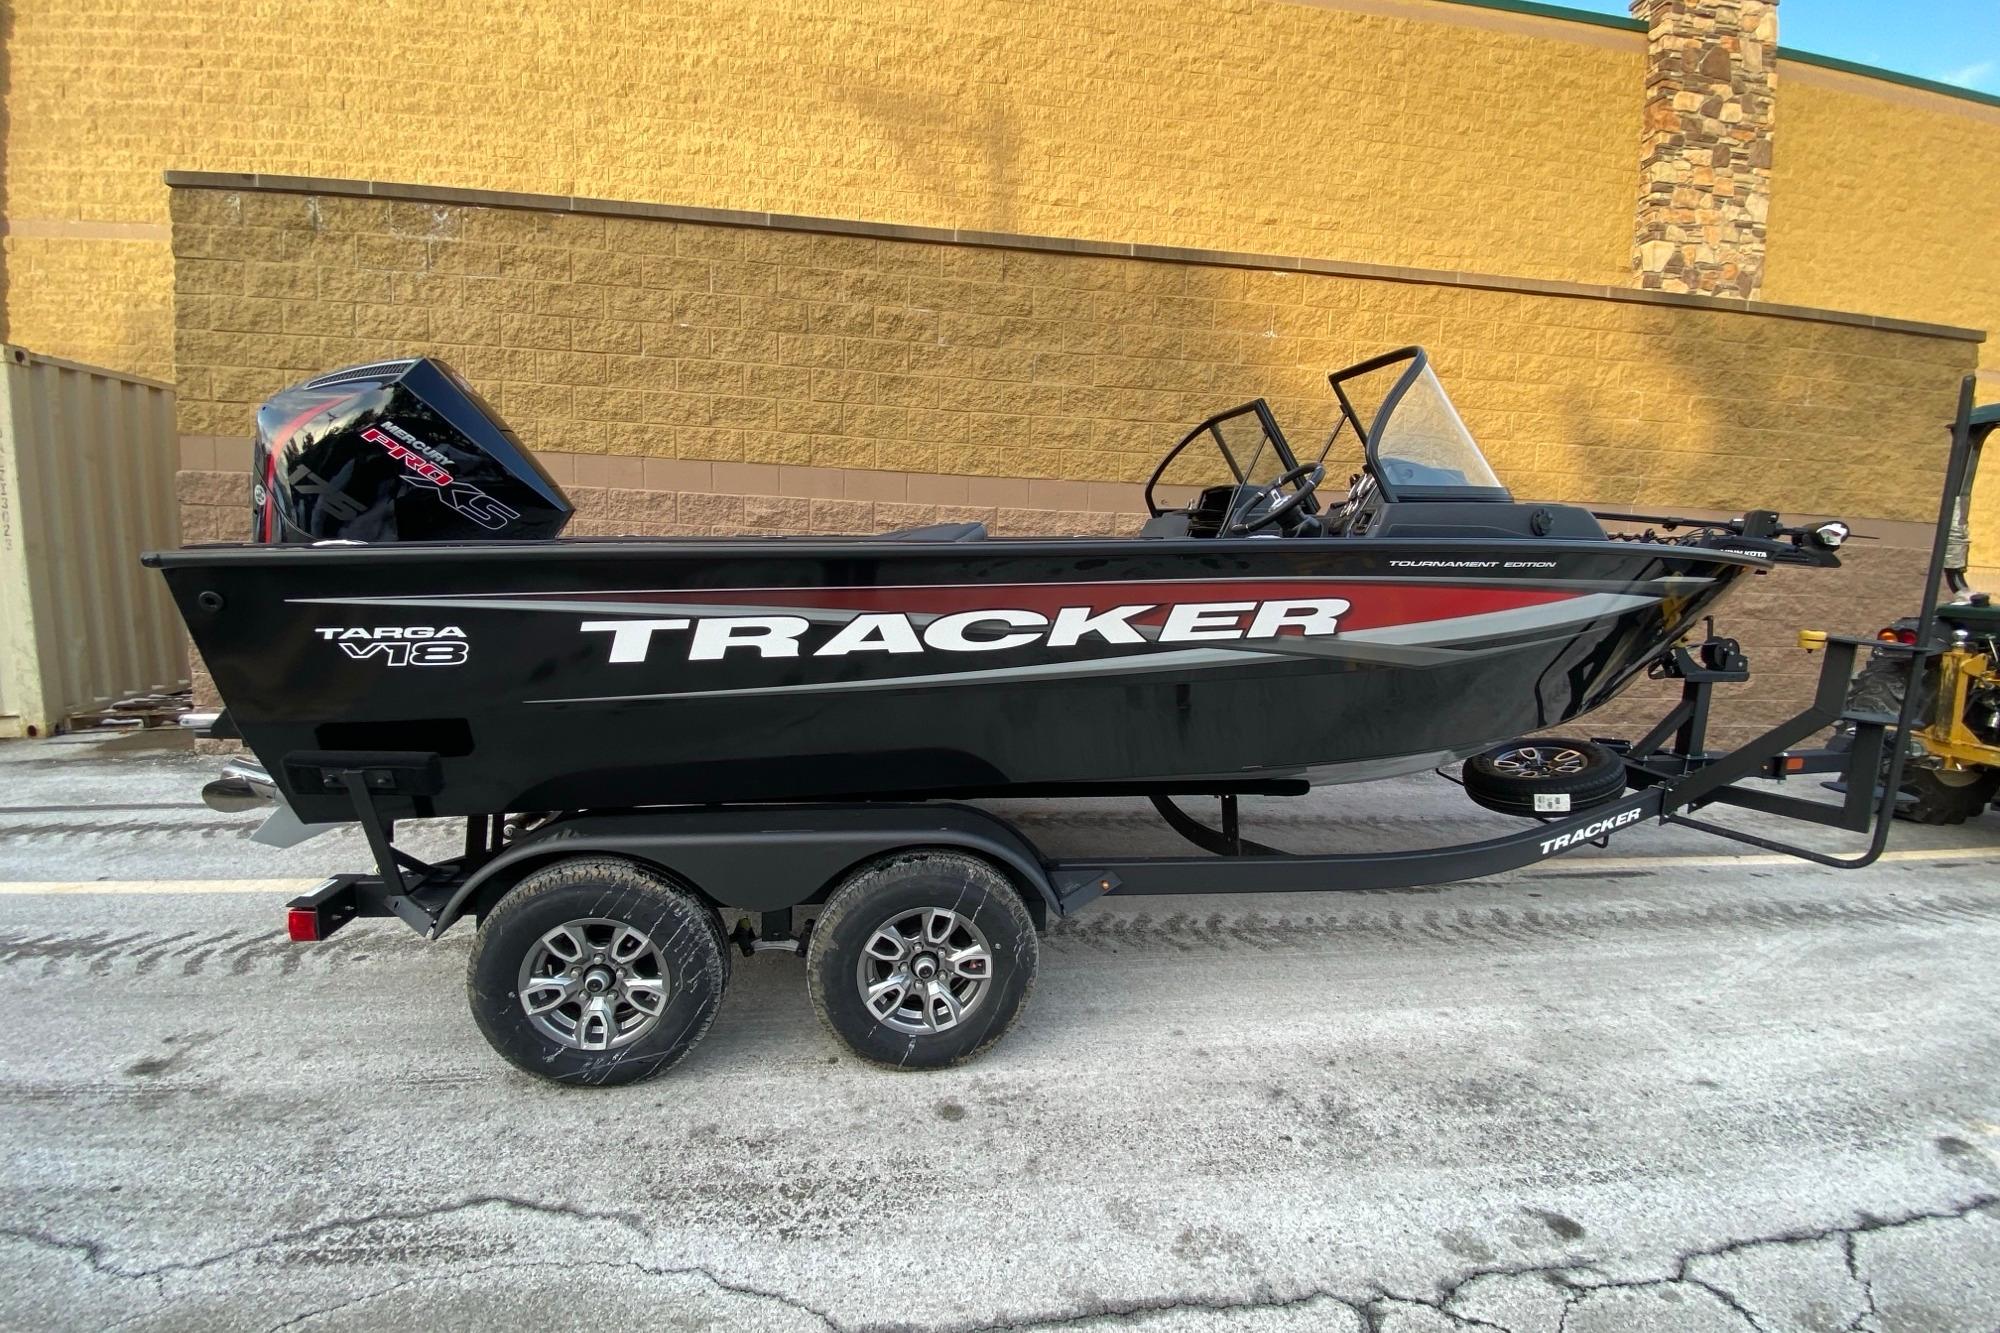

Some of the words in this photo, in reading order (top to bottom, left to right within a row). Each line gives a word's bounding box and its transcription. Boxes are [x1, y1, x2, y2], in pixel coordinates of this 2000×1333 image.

[361, 428, 454, 487] PRO
[380, 421, 455, 466] MERCURY
[399, 474, 521, 530] XS
[1389, 560, 1500, 568] TOURNAMENT
[1744, 550, 1768, 558] KOTA
[314, 626, 468, 640] TARGA
[580, 598, 1351, 663] TRACKER
[338, 641, 470, 667] V18
[1540, 807, 1642, 855] TRACKER
